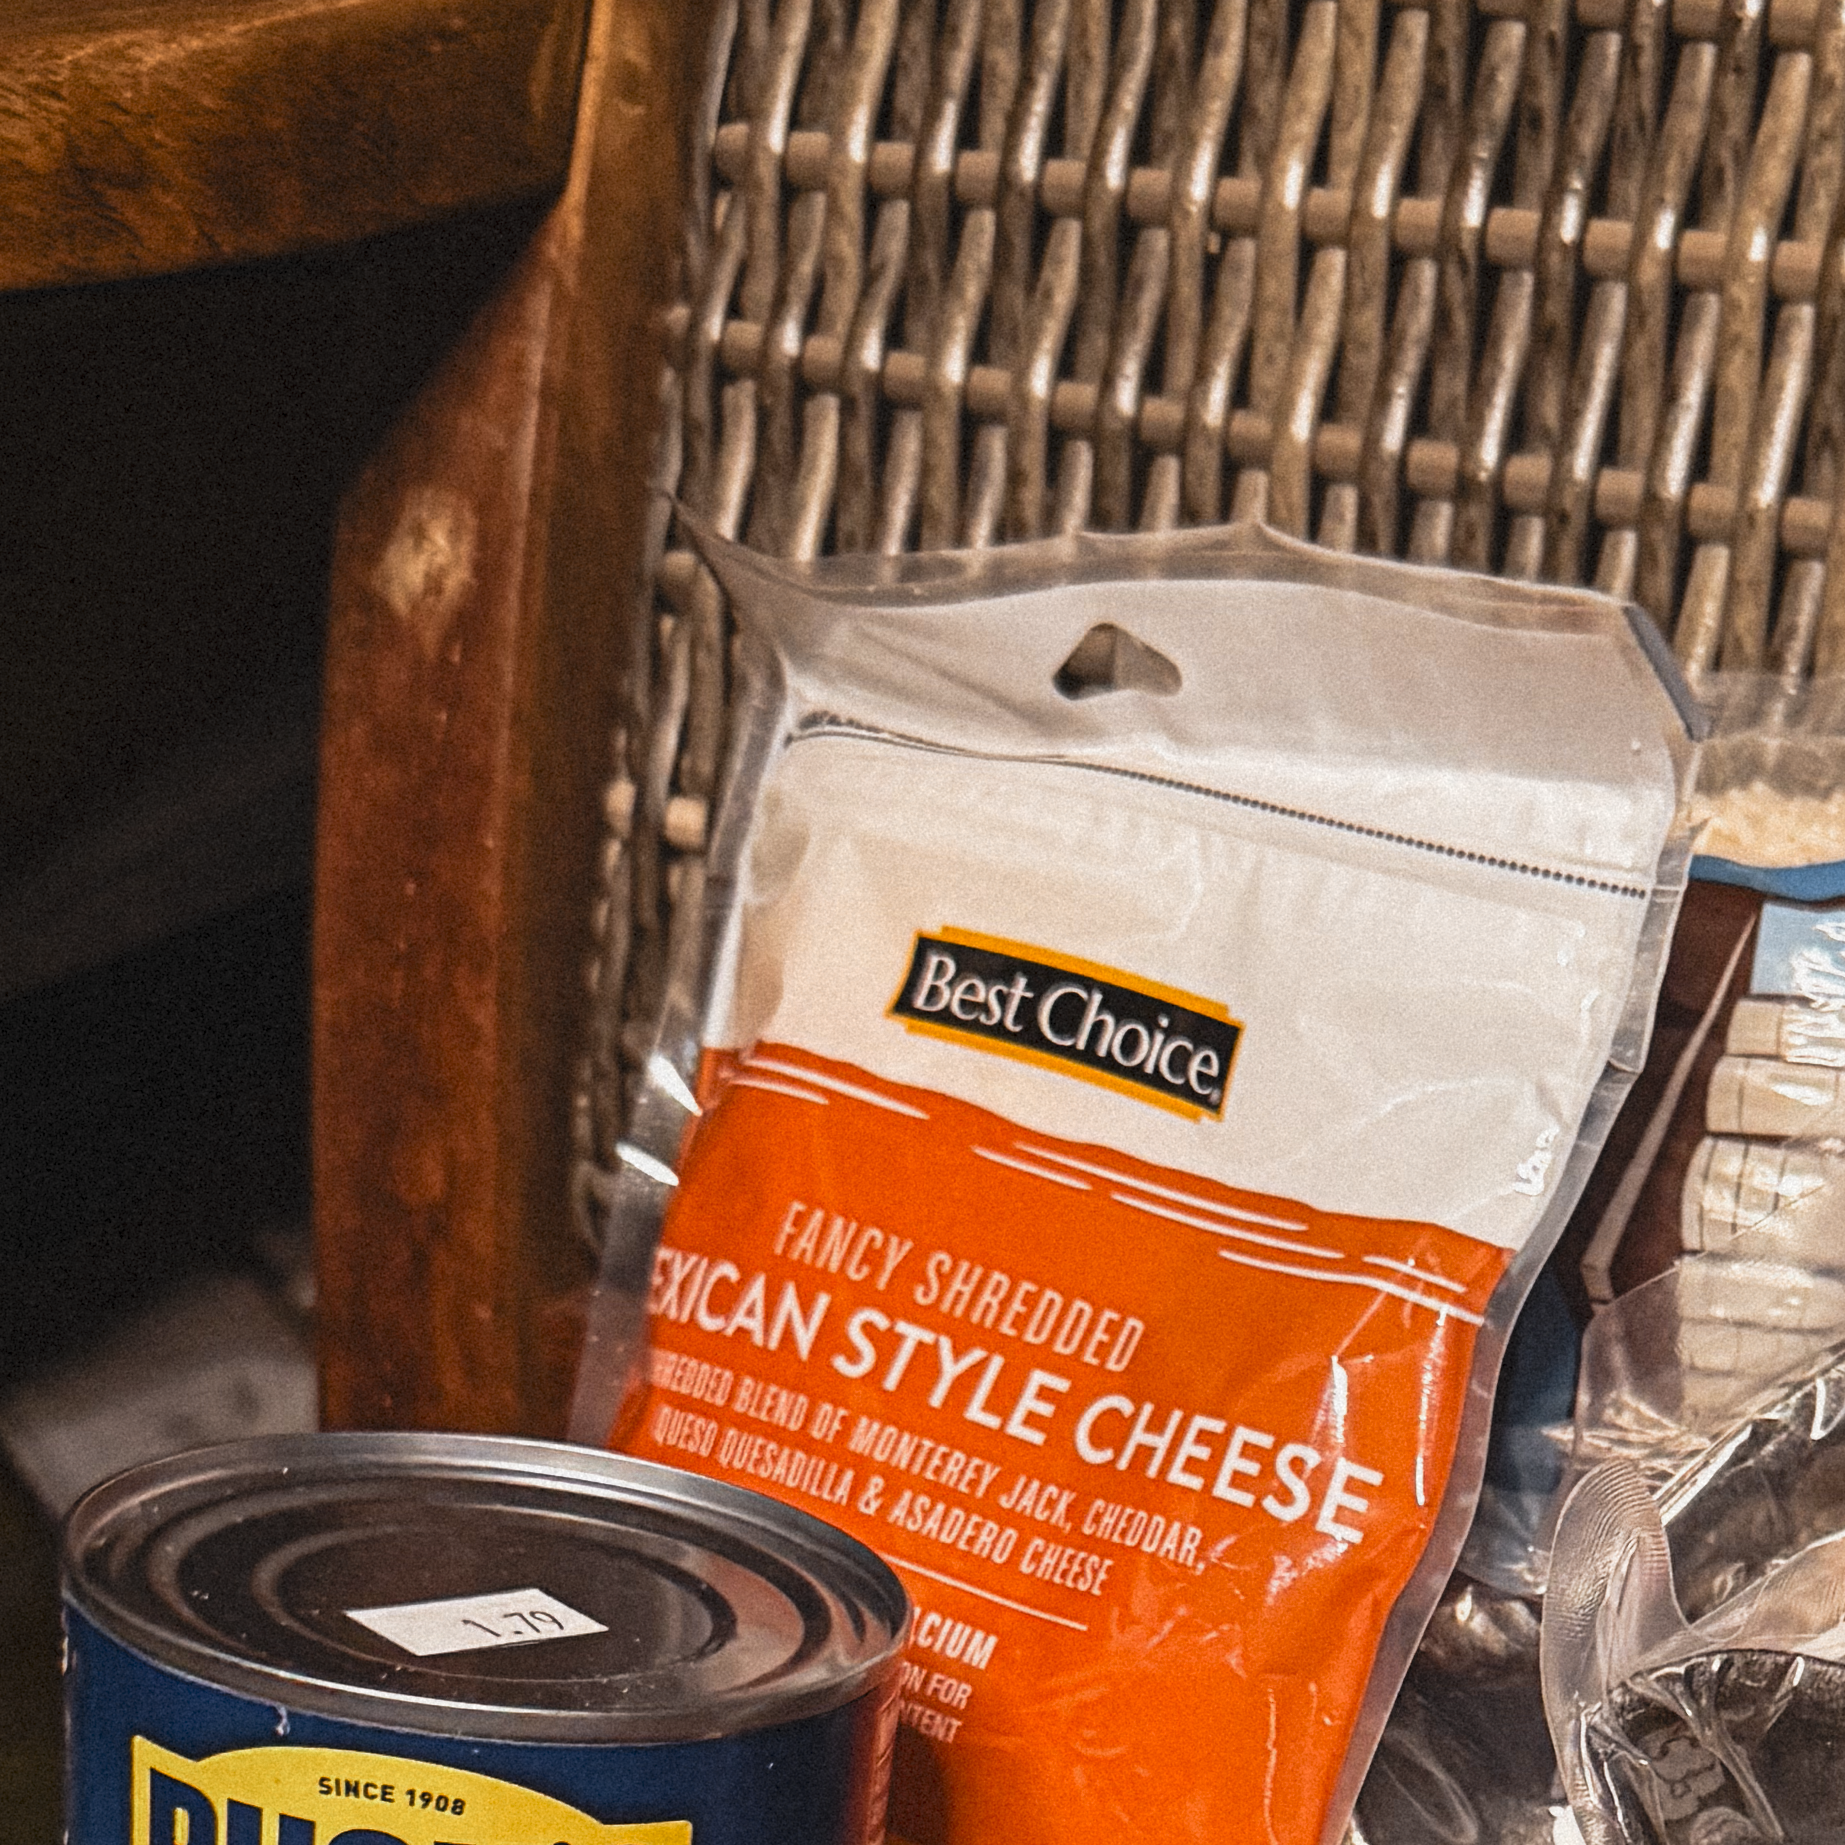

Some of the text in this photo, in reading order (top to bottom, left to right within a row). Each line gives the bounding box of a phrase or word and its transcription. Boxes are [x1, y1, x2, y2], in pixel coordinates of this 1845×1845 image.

[912, 950, 1220, 1096] Best Choice
[773, 1201, 1145, 1372] FANCY SHREDDED
[647, 1246, 1384, 1544] EXICAN STYLE CHEESE
[653, 1404, 1114, 1597] QUESO QUESADILLA & ASADERO CHEESE
[733, 1374, 810, 1431] BLEND
[808, 1401, 849, 1444] OF
[848, 1416, 1001, 1500] MONTEREY
[999, 1475, 1077, 1535] JACK,
[1081, 1499, 1205, 1575] CHEDDAR,
[462, 1611, 565, 1638] 1.79
[926, 1671, 973, 1710] FOR
[317, 1776, 467, 1816] SINCE 1908
